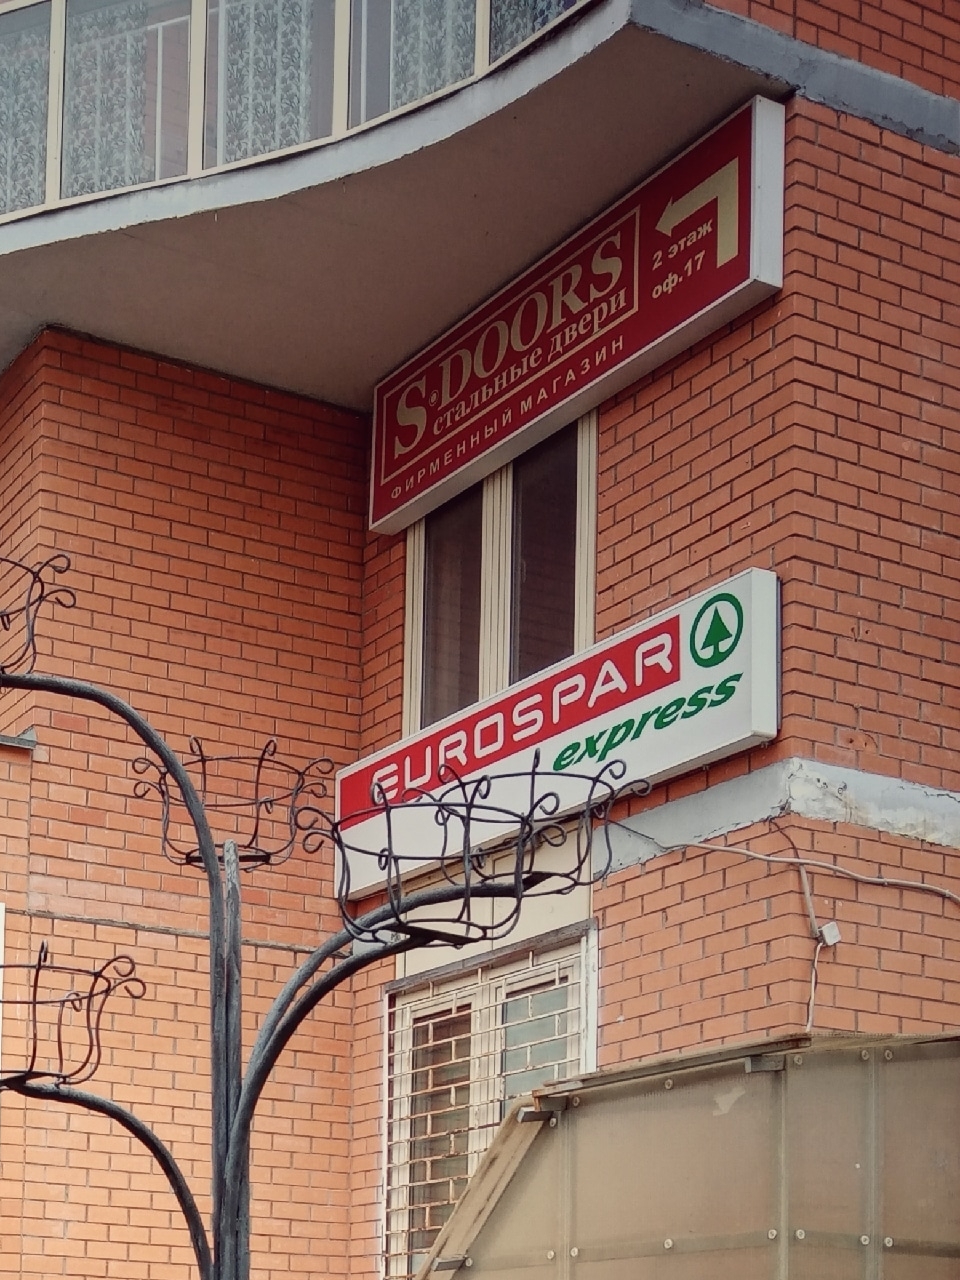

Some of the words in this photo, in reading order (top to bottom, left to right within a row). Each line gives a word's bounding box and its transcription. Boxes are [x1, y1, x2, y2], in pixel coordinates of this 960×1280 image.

[651, 249, 663, 271] 2
[667, 218, 713, 259] этаж
[390, 406, 513, 499] ФИРМЕННЫЙ
[519, 334, 624, 415] МАГАЗИН
[432, 346, 543, 436] стальные
[547, 286, 628, 362] двери
[371, 632, 675, 805] EUROSPAR
[552, 672, 744, 772] express
